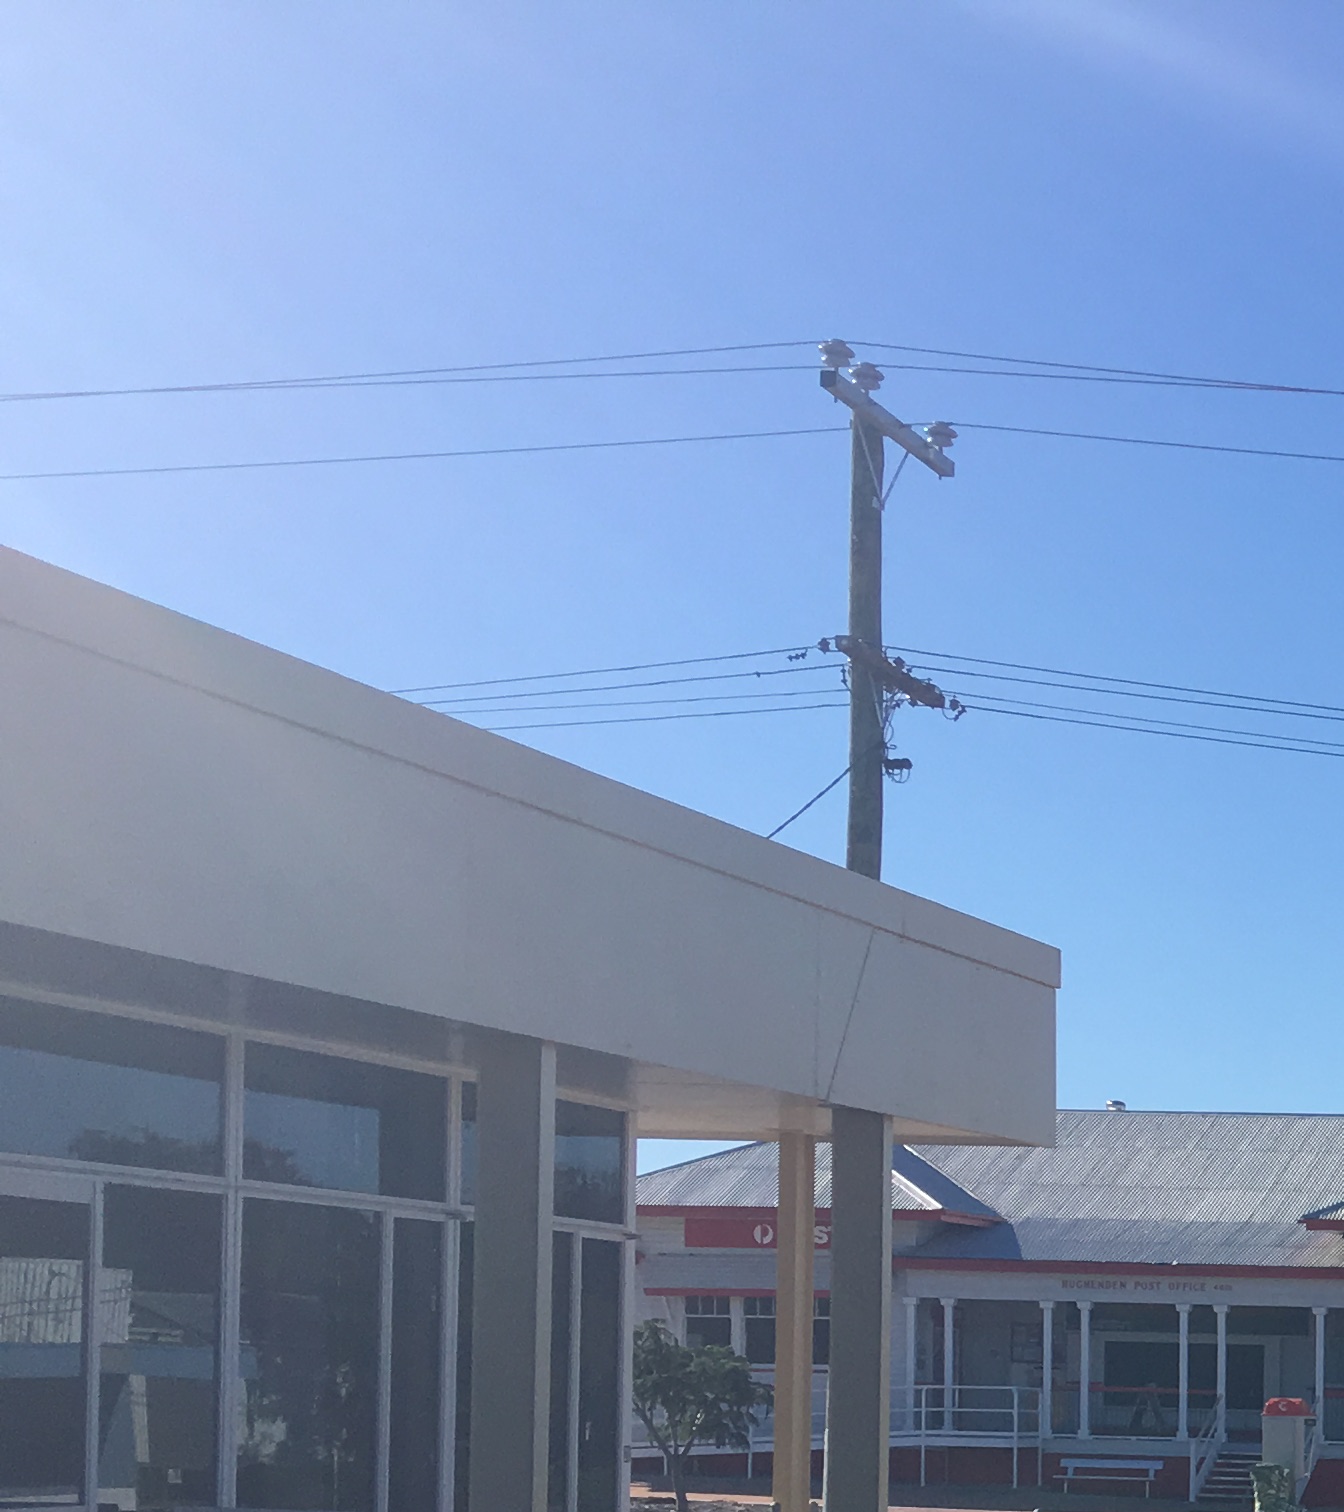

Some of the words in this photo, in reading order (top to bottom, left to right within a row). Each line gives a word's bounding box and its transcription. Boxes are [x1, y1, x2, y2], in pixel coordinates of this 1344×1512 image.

[1061, 1279, 1127, 1289] HUGHENDEN
[1134, 1280, 1162, 1290] POST
[1168, 1282, 1206, 1291] OFFICE
